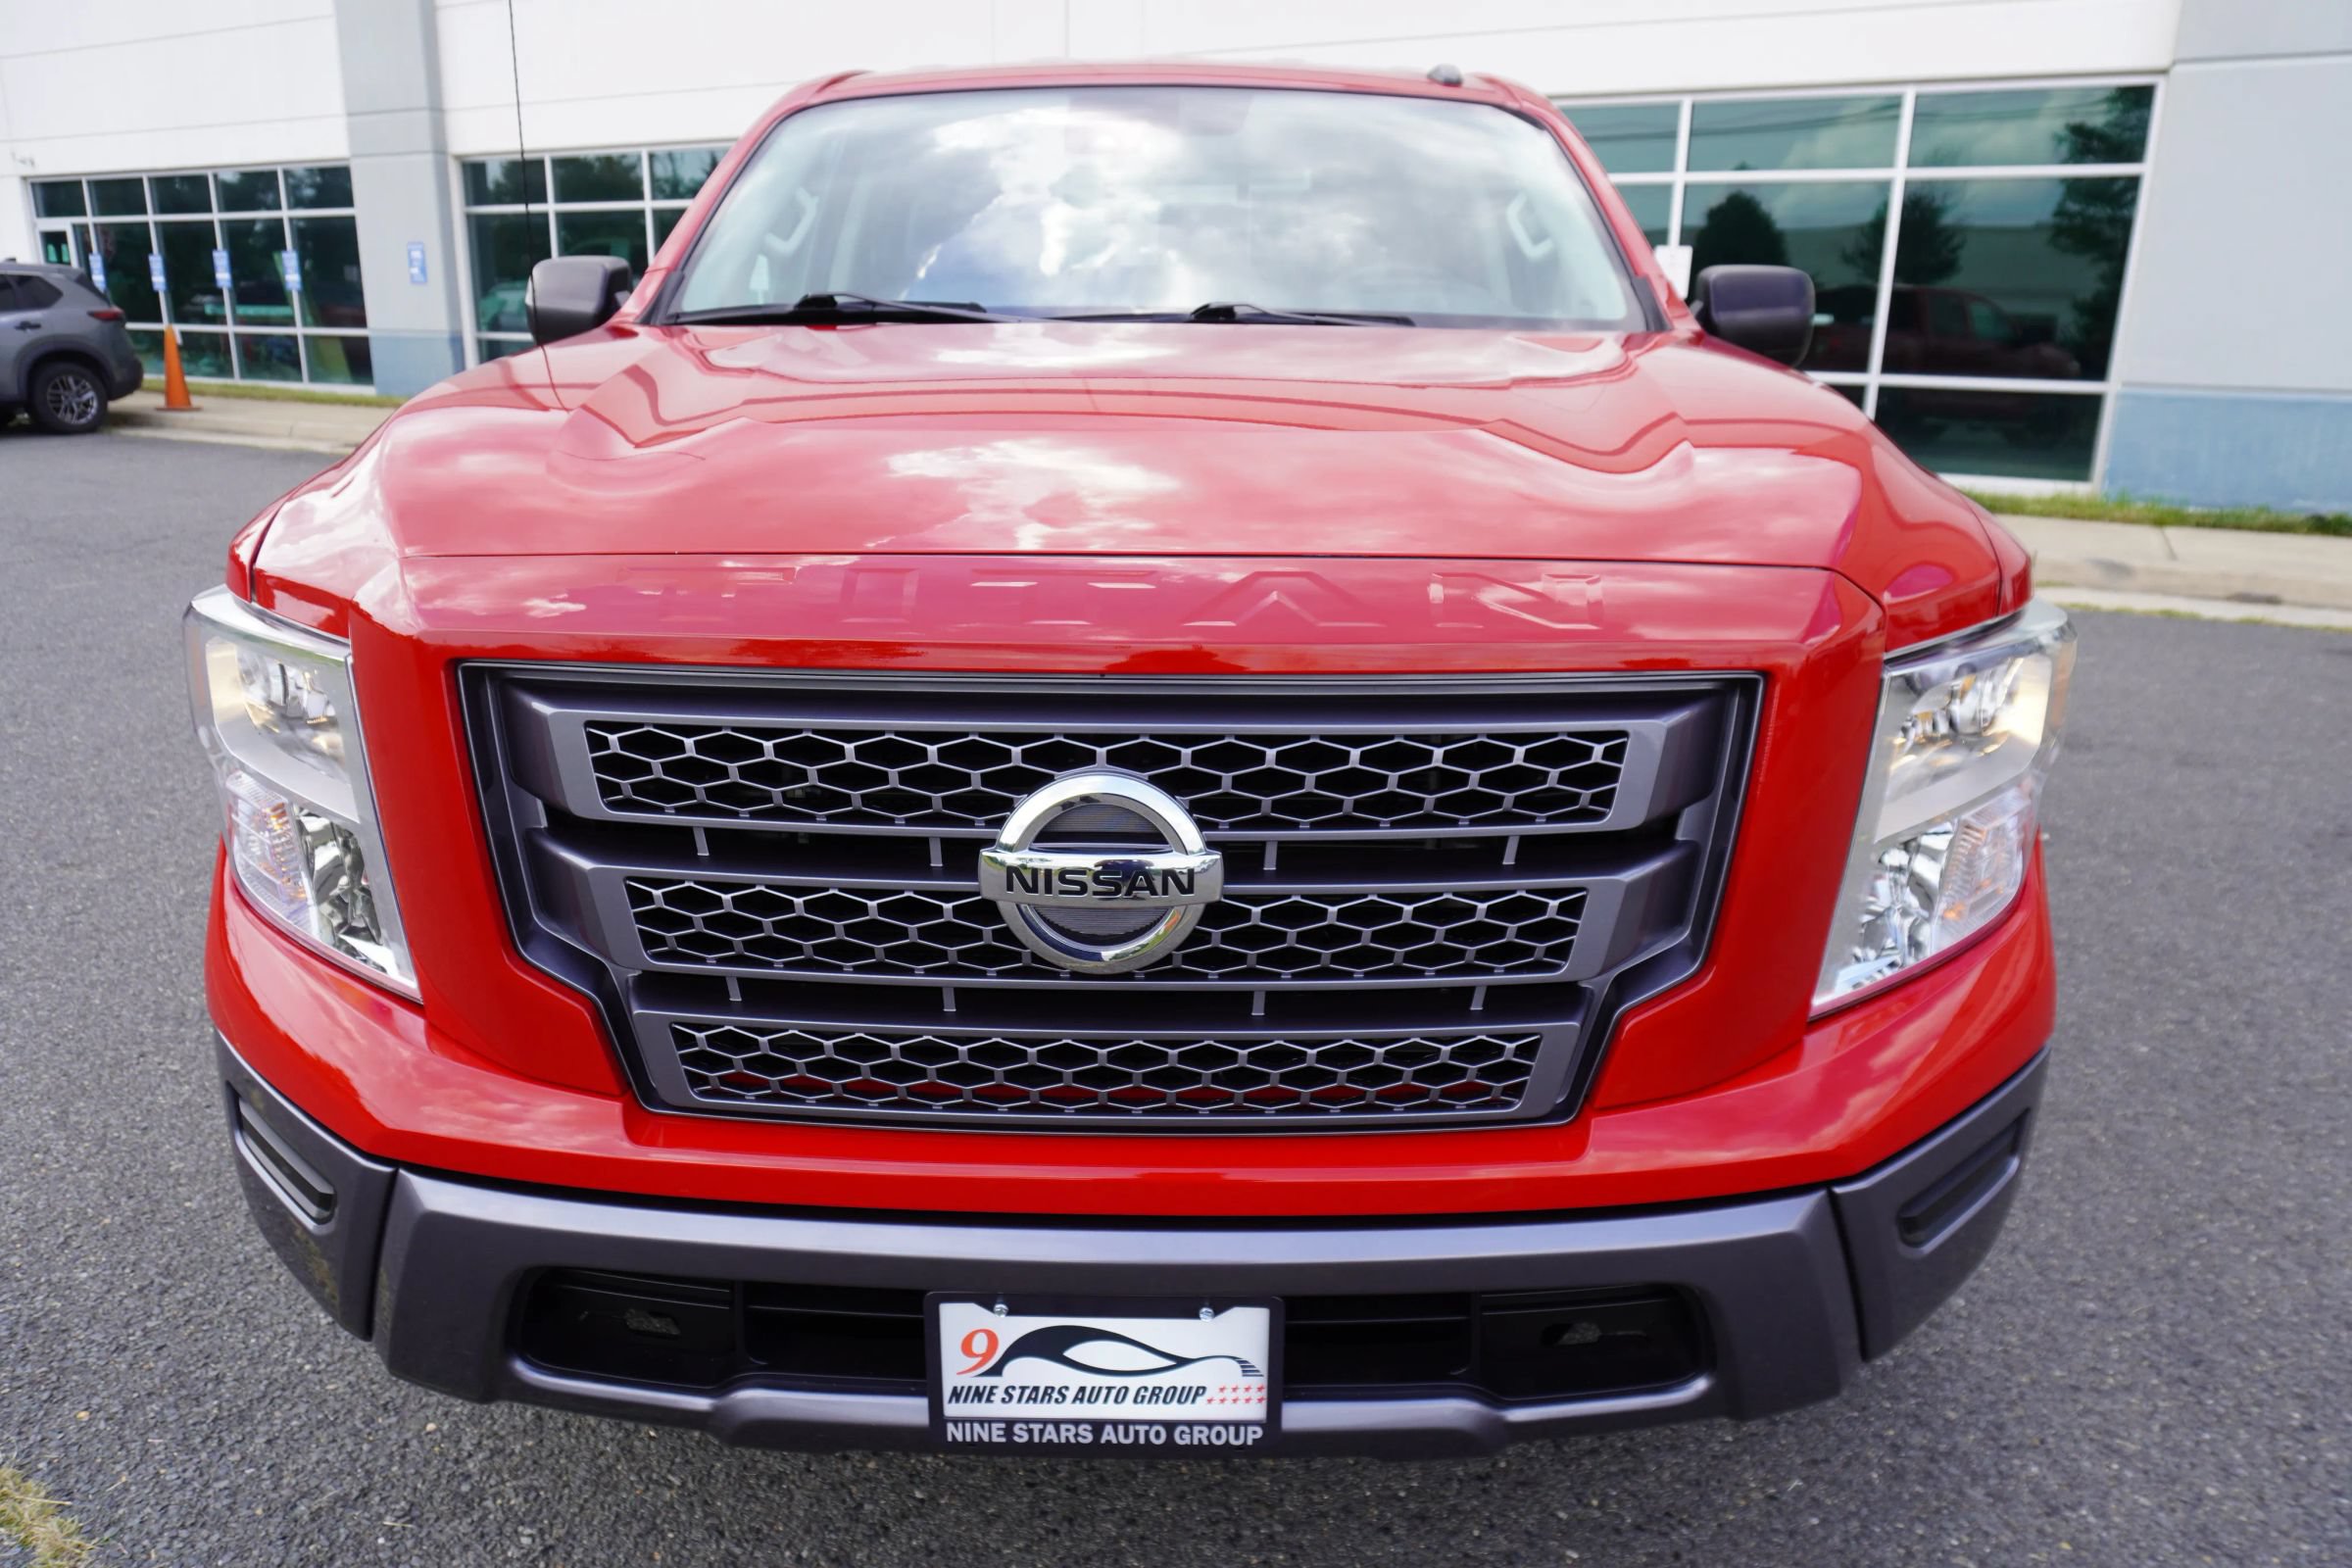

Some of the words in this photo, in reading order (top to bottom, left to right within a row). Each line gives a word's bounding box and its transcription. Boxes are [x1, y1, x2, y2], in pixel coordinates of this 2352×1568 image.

[1005, 865, 1195, 898] NISSAN
[948, 1385, 998, 1405] NINE
[1001, 1385, 1068, 1405] STARS
[1072, 1385, 1128, 1405] AUTO
[1133, 1385, 1206, 1406] GROUP
[947, 1423, 1006, 1444] NINE
[1012, 1423, 1093, 1446] STARS
[1100, 1424, 1167, 1446] AUTO
[1173, 1424, 1263, 1446] GROUP
